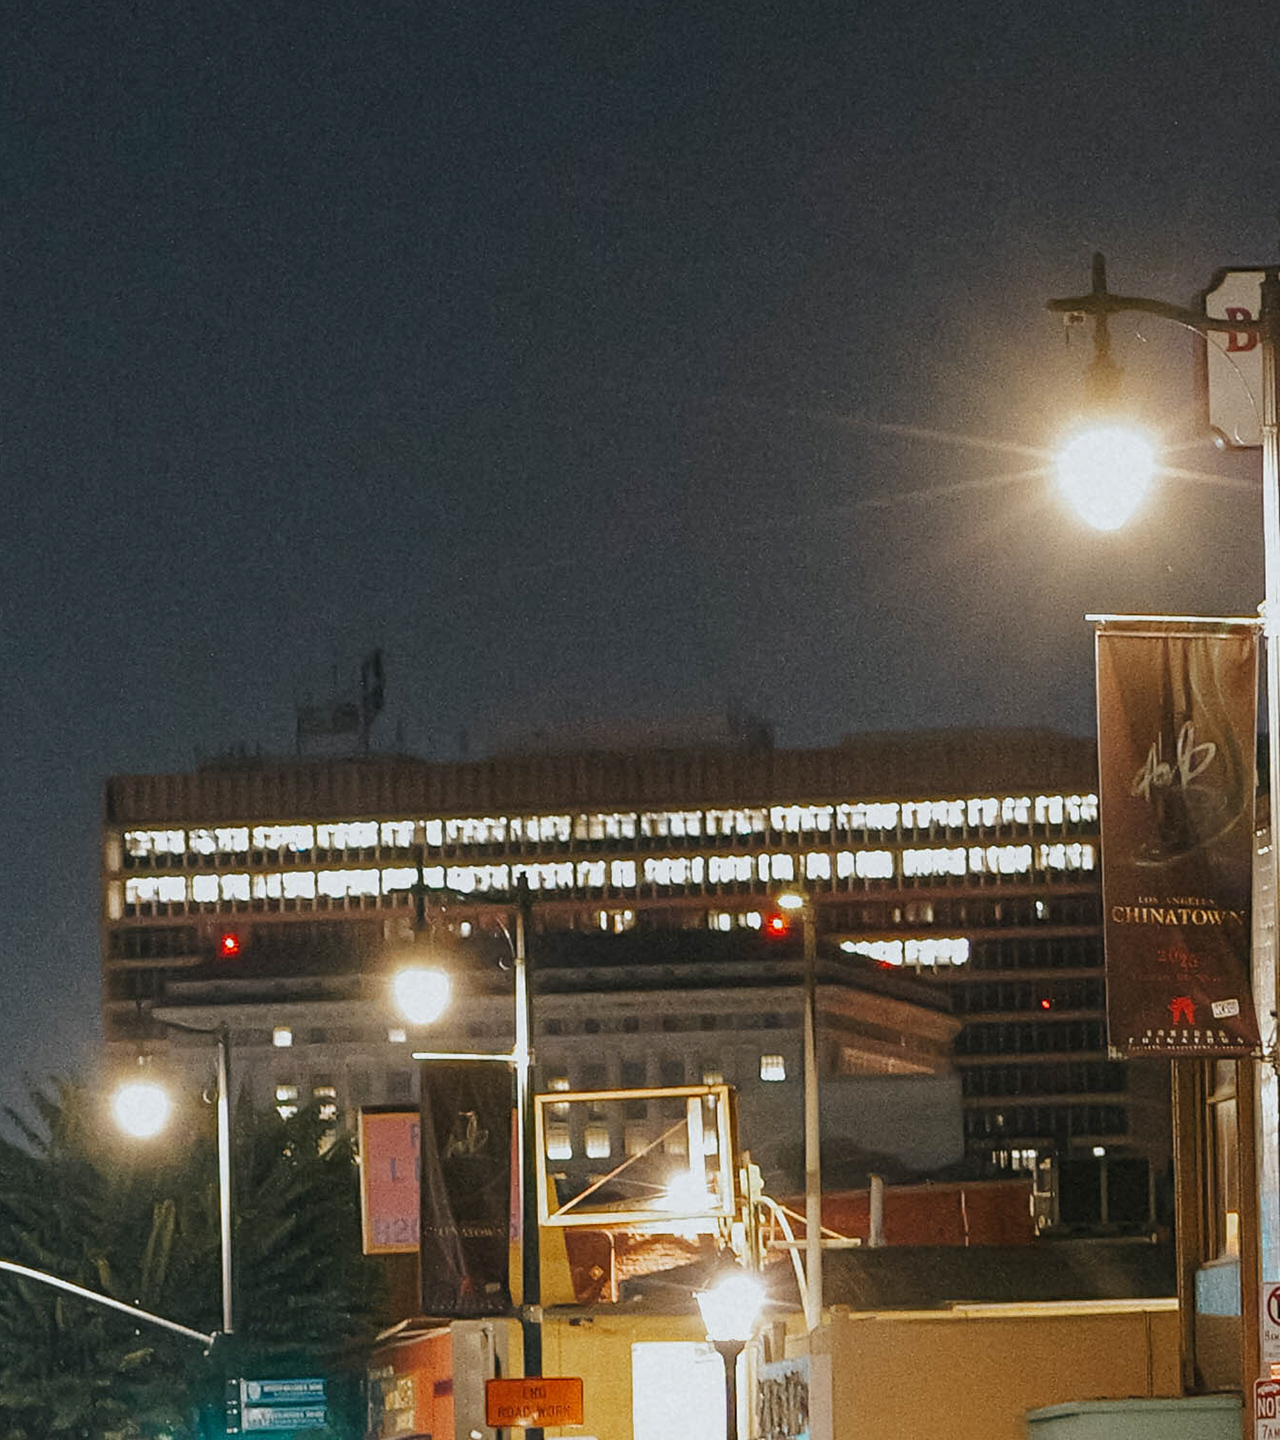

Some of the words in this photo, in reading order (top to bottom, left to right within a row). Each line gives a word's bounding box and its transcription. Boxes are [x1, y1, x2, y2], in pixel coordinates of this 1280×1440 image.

[1138, 896, 1159, 904] LOS
[1111, 906, 1245, 926] CHINATOWN
[1257, 1397, 1275, 1418] NO
